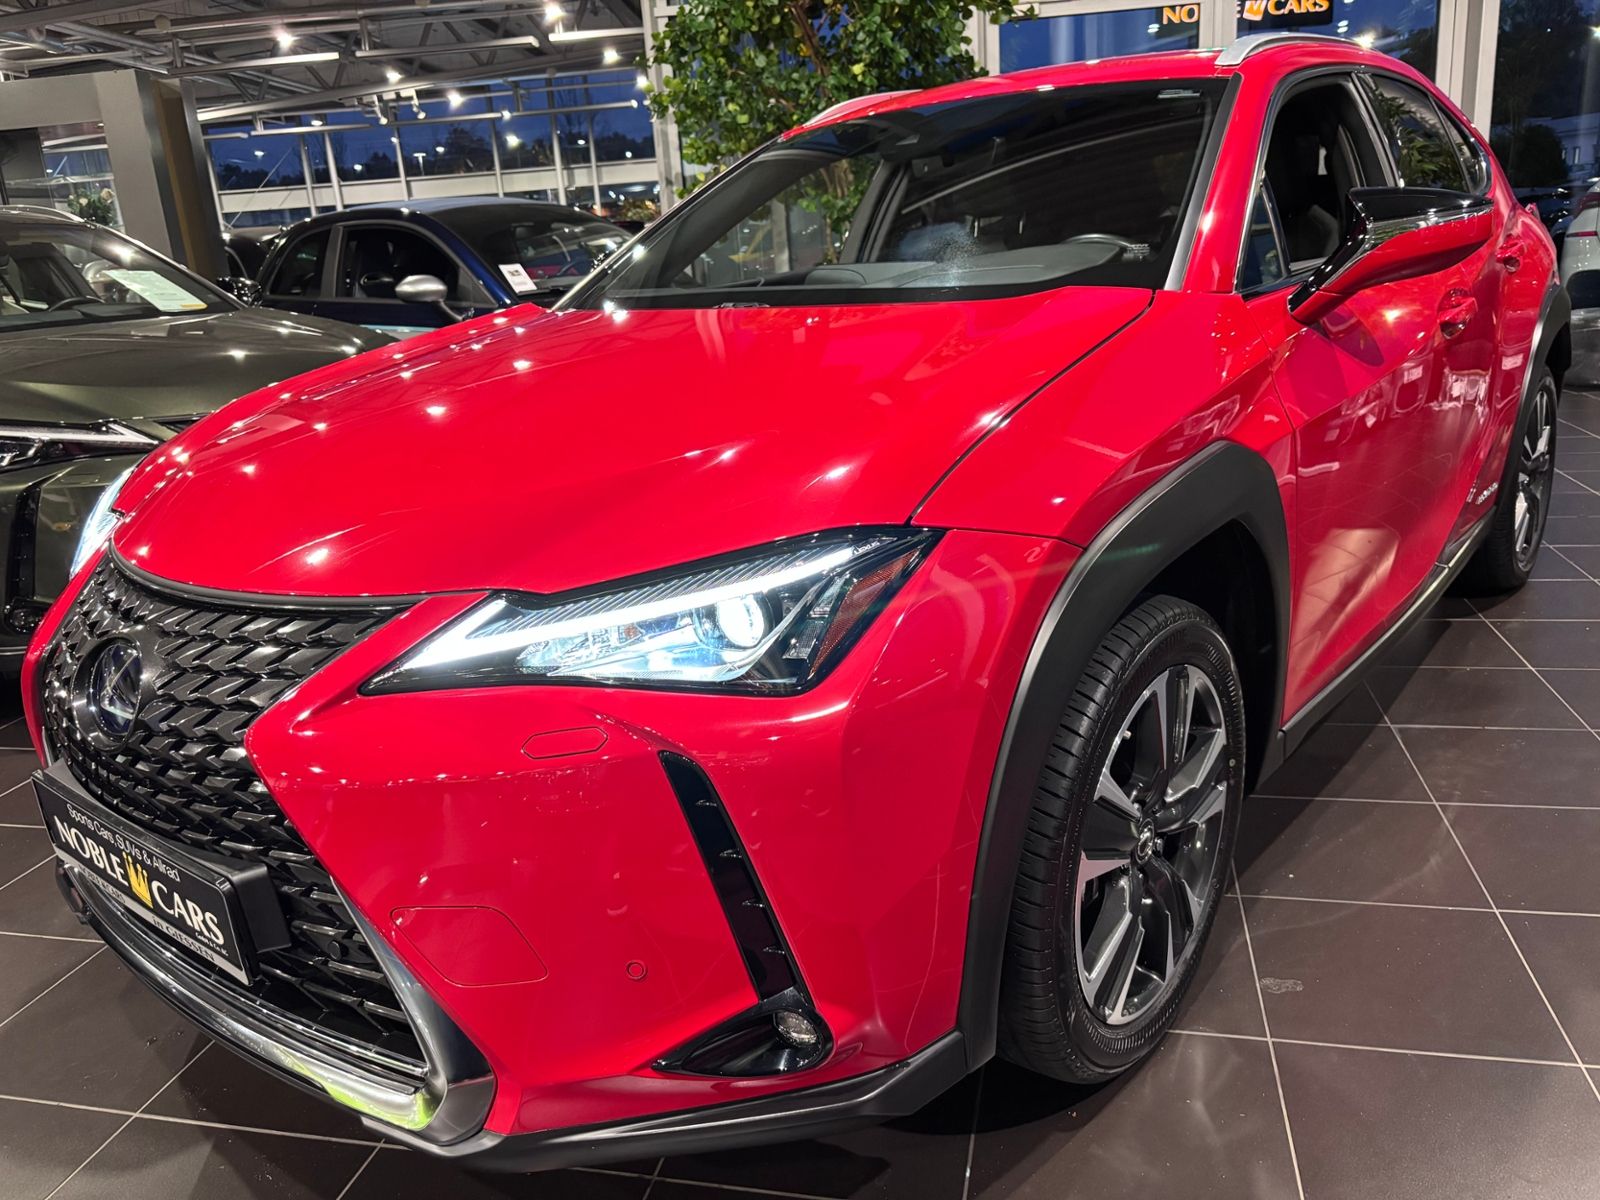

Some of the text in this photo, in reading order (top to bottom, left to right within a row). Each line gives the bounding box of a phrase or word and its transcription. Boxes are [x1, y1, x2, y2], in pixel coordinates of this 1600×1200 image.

[1267, 0, 1329, 15] CARS
[67, 803, 95, 831] Sports
[115, 834, 142, 860] SUVs
[142, 850, 152, 866] &
[53, 815, 129, 887] NOBLE
[151, 880, 224, 945] CARS
